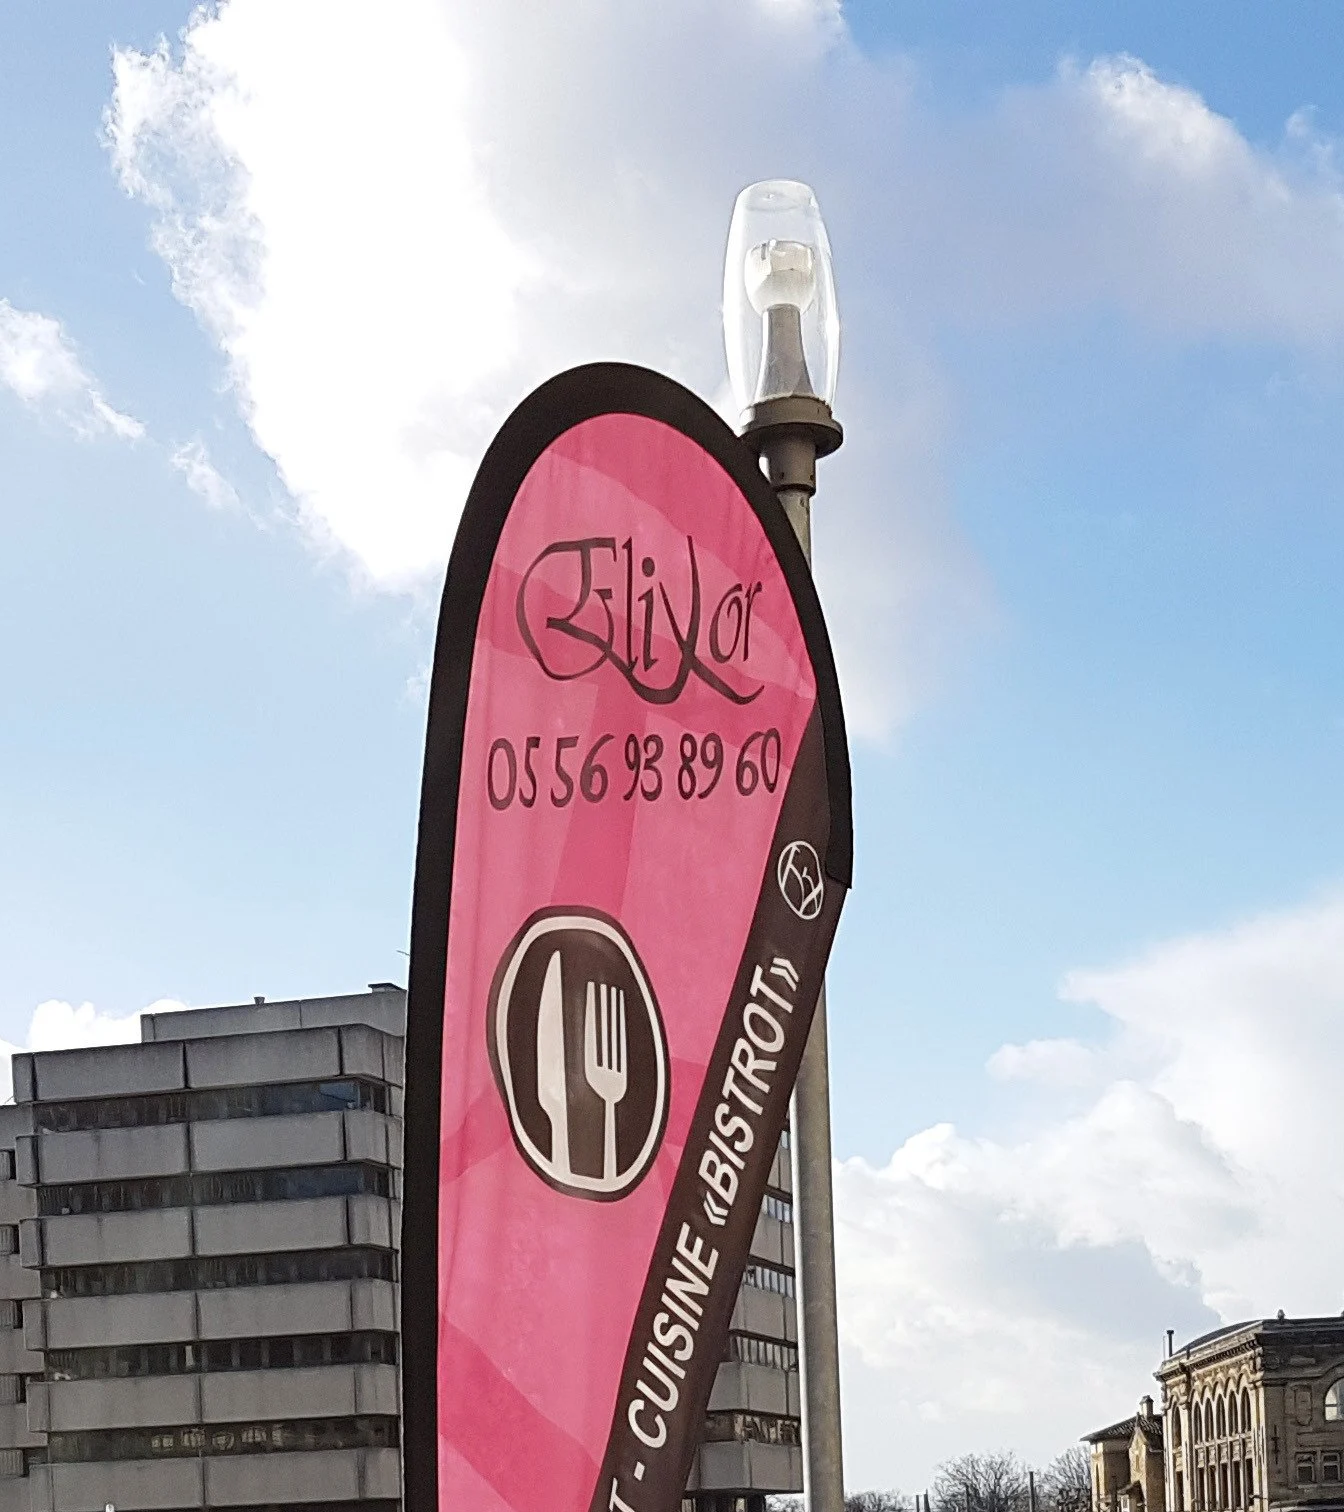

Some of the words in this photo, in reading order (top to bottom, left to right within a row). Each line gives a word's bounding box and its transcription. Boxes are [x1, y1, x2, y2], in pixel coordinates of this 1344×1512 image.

[487, 736, 541, 811] 05
[550, 732, 615, 804] 56
[623, 732, 665, 802] 93
[677, 732, 724, 800] 89
[735, 727, 782, 797] 60
[627, 1221, 719, 1449] CUISINE
